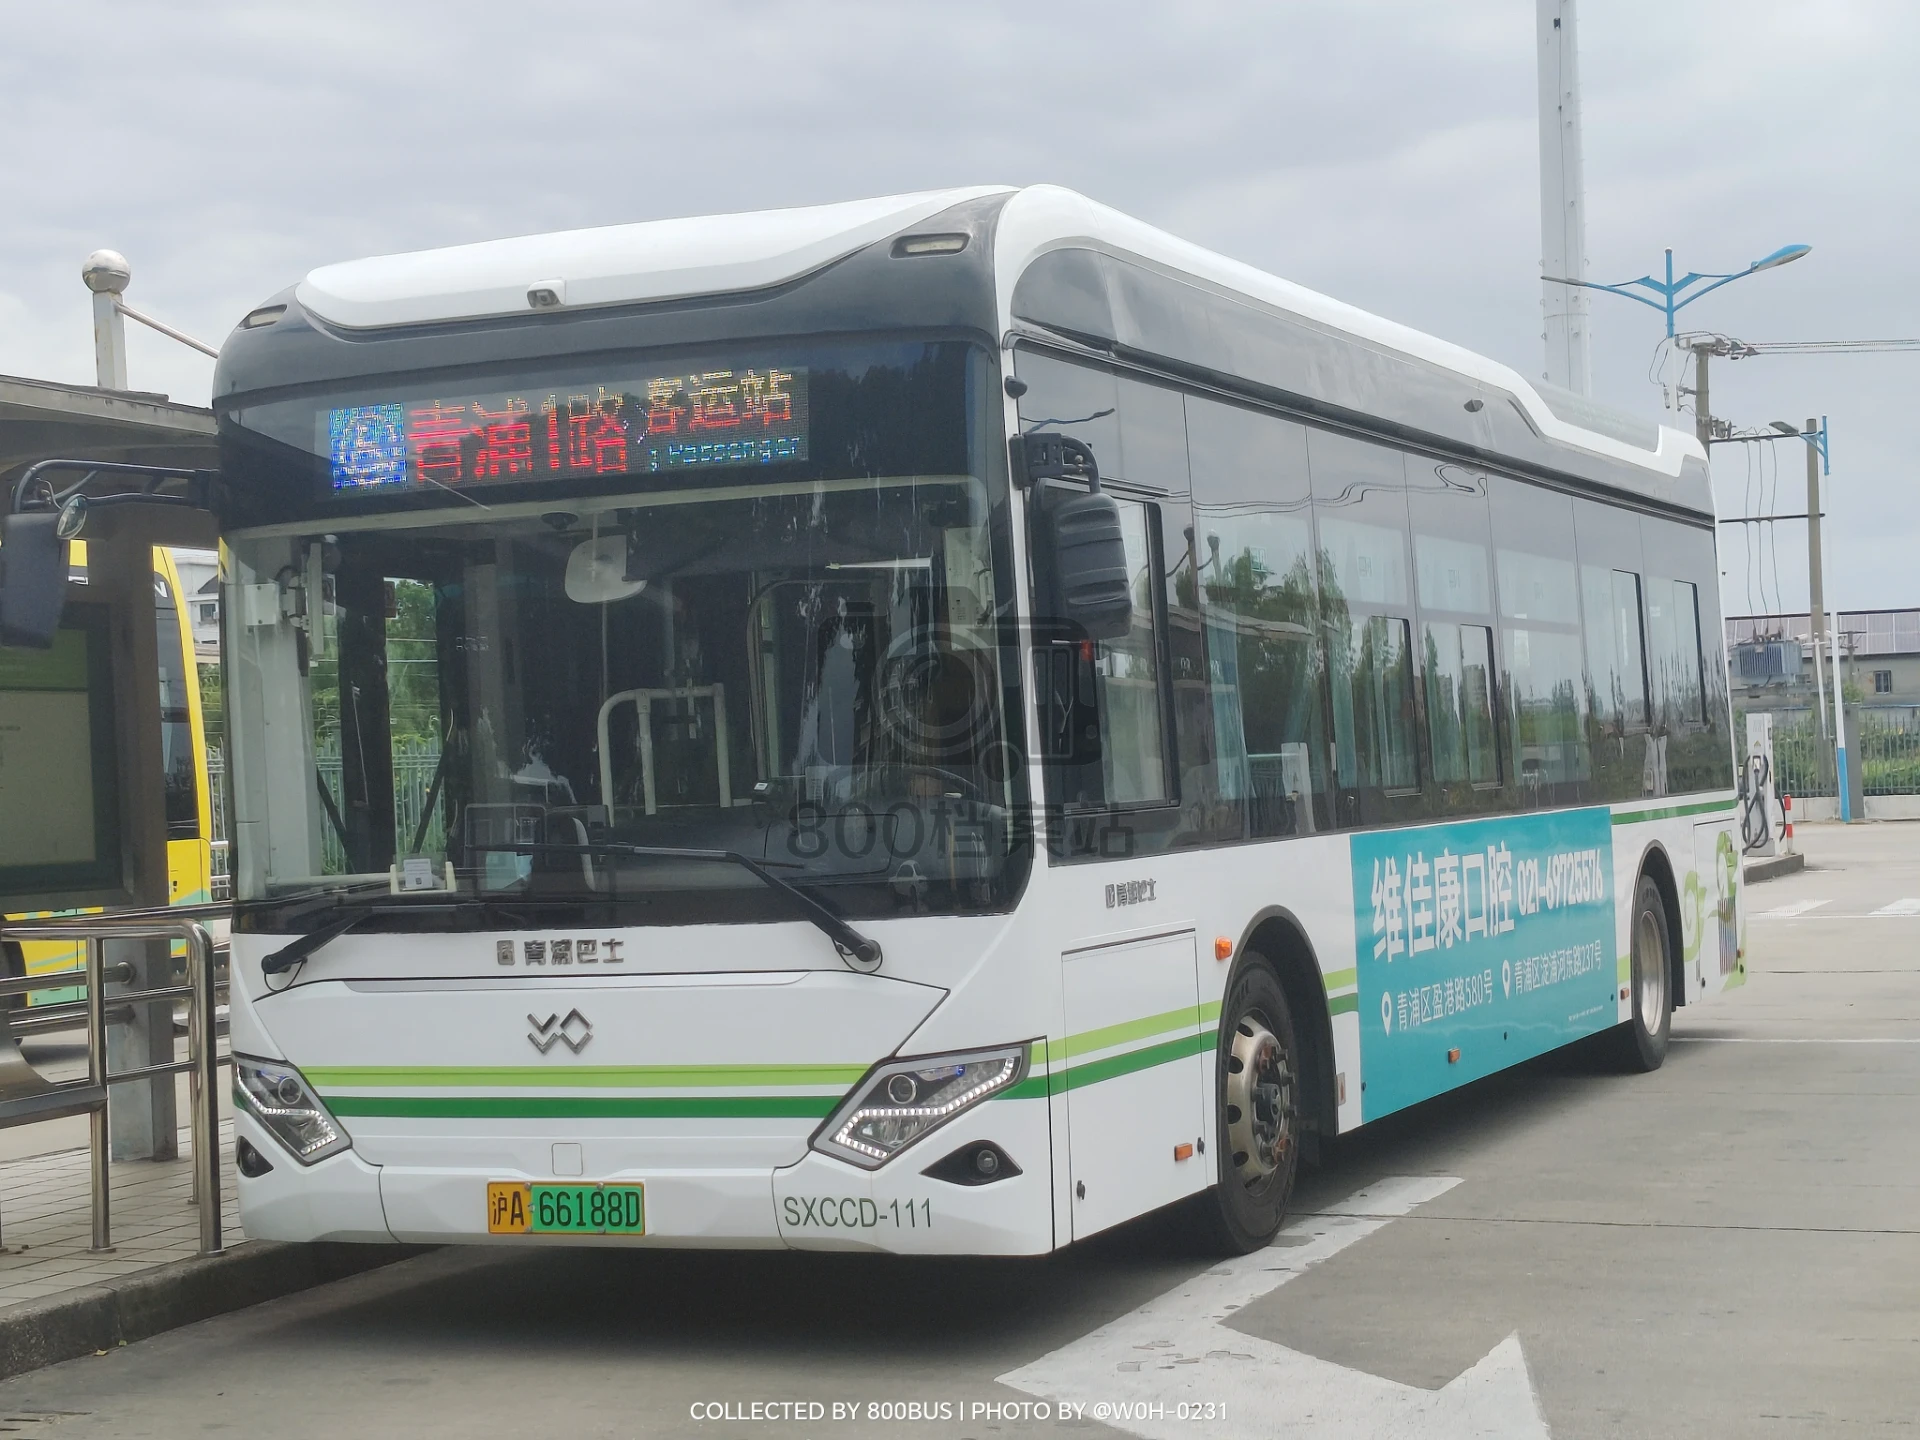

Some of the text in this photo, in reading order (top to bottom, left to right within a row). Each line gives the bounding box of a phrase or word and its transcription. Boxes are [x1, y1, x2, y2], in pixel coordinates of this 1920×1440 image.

[1371, 840, 1604, 963] 维佳康口腔 021-69725576
[524, 938, 625, 966] 青浦巴士
[1397, 968, 1493, 1032] 青浦区盈港路580号
[783, 1196, 932, 1229] SXCCD-111
